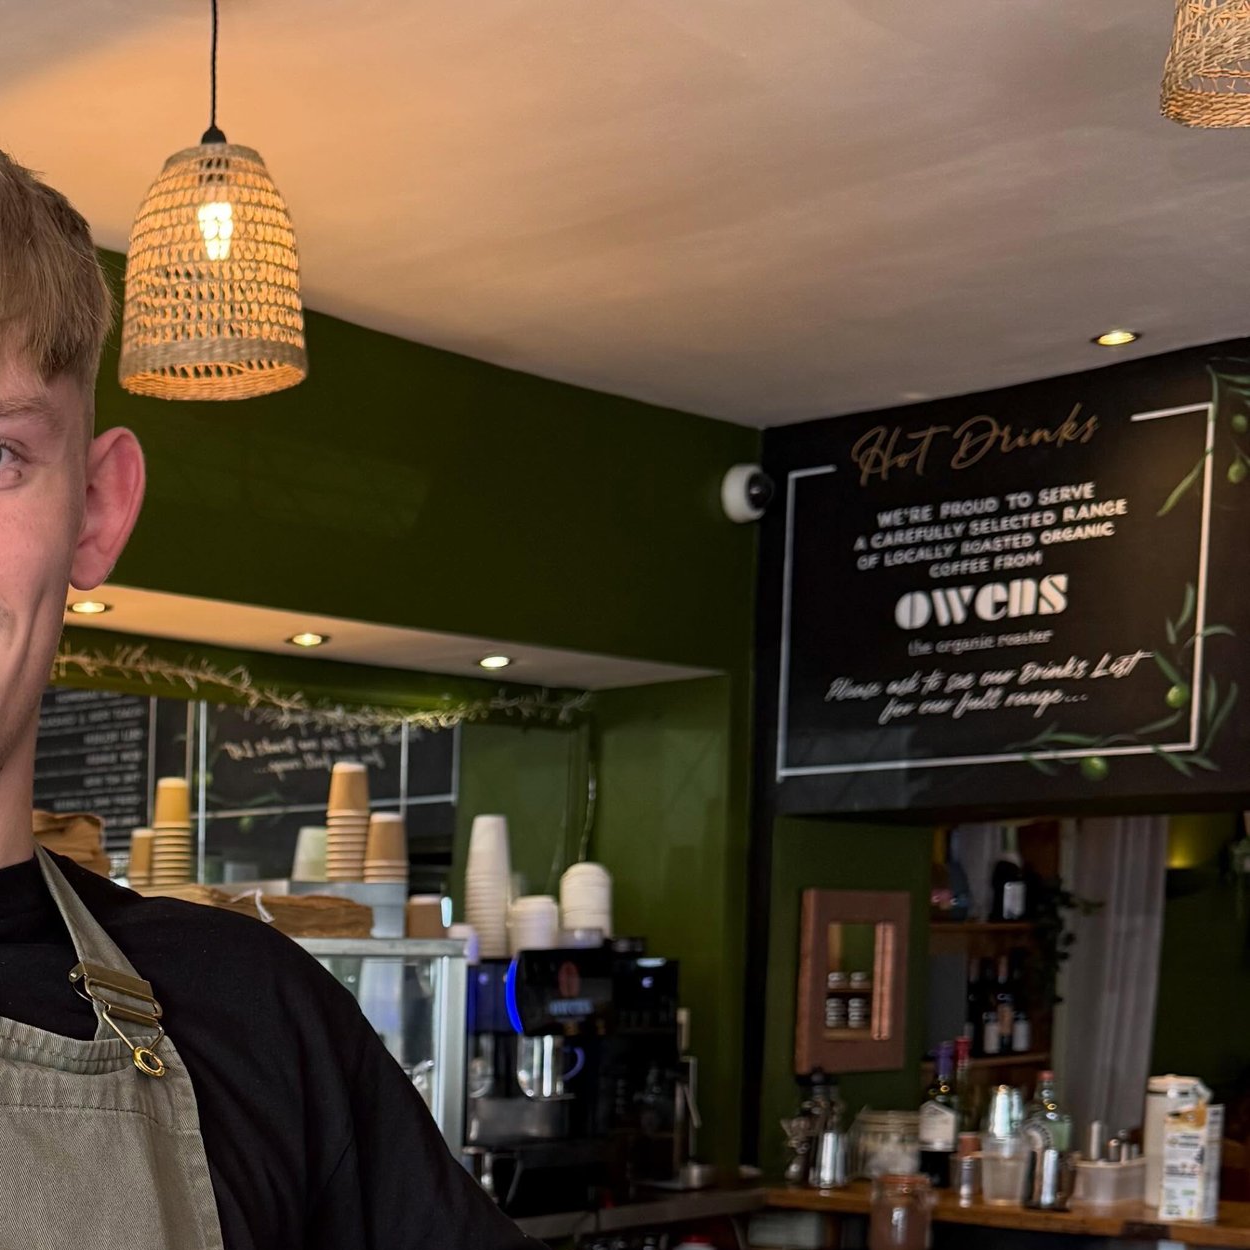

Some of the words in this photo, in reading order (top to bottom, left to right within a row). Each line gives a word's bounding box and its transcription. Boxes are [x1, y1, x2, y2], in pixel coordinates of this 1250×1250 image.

[851, 424, 951, 487] Hot
[950, 402, 1099, 470] Drinks
[853, 535, 868, 552] A
[870, 521, 967, 550] CAREFULLY
[968, 510, 1057, 536] SELECTED
[1062, 499, 1128, 523] RANGE
[877, 504, 934, 529] WE'RE
[940, 496, 1000, 520] PROUD
[1006, 490, 1034, 510] TO
[1038, 481, 1096, 507] SERVE
[857, 554, 880, 571] OF
[884, 542, 957, 568] LOCALLY
[960, 532, 1035, 556] ROASTED
[1040, 521, 1115, 545] ORGANIC
[929, 558, 990, 579] COFFEE
[993, 551, 1043, 571] FROM
[895, 574, 1069, 630] owens
[908, 638, 933, 657] the
[935, 634, 995, 656] organic
[997, 629, 1054, 648] roaster
[824, 676, 883, 702] Please
[885, 670, 920, 695] ask
[921, 669, 947, 695] to
[979, 669, 1018, 687] our
[1017, 655, 1089, 686] Drinks
[1089, 648, 1156, 679] List
[878, 697, 917, 726] for
[918, 697, 955, 715] our
[952, 687, 1004, 720] full
